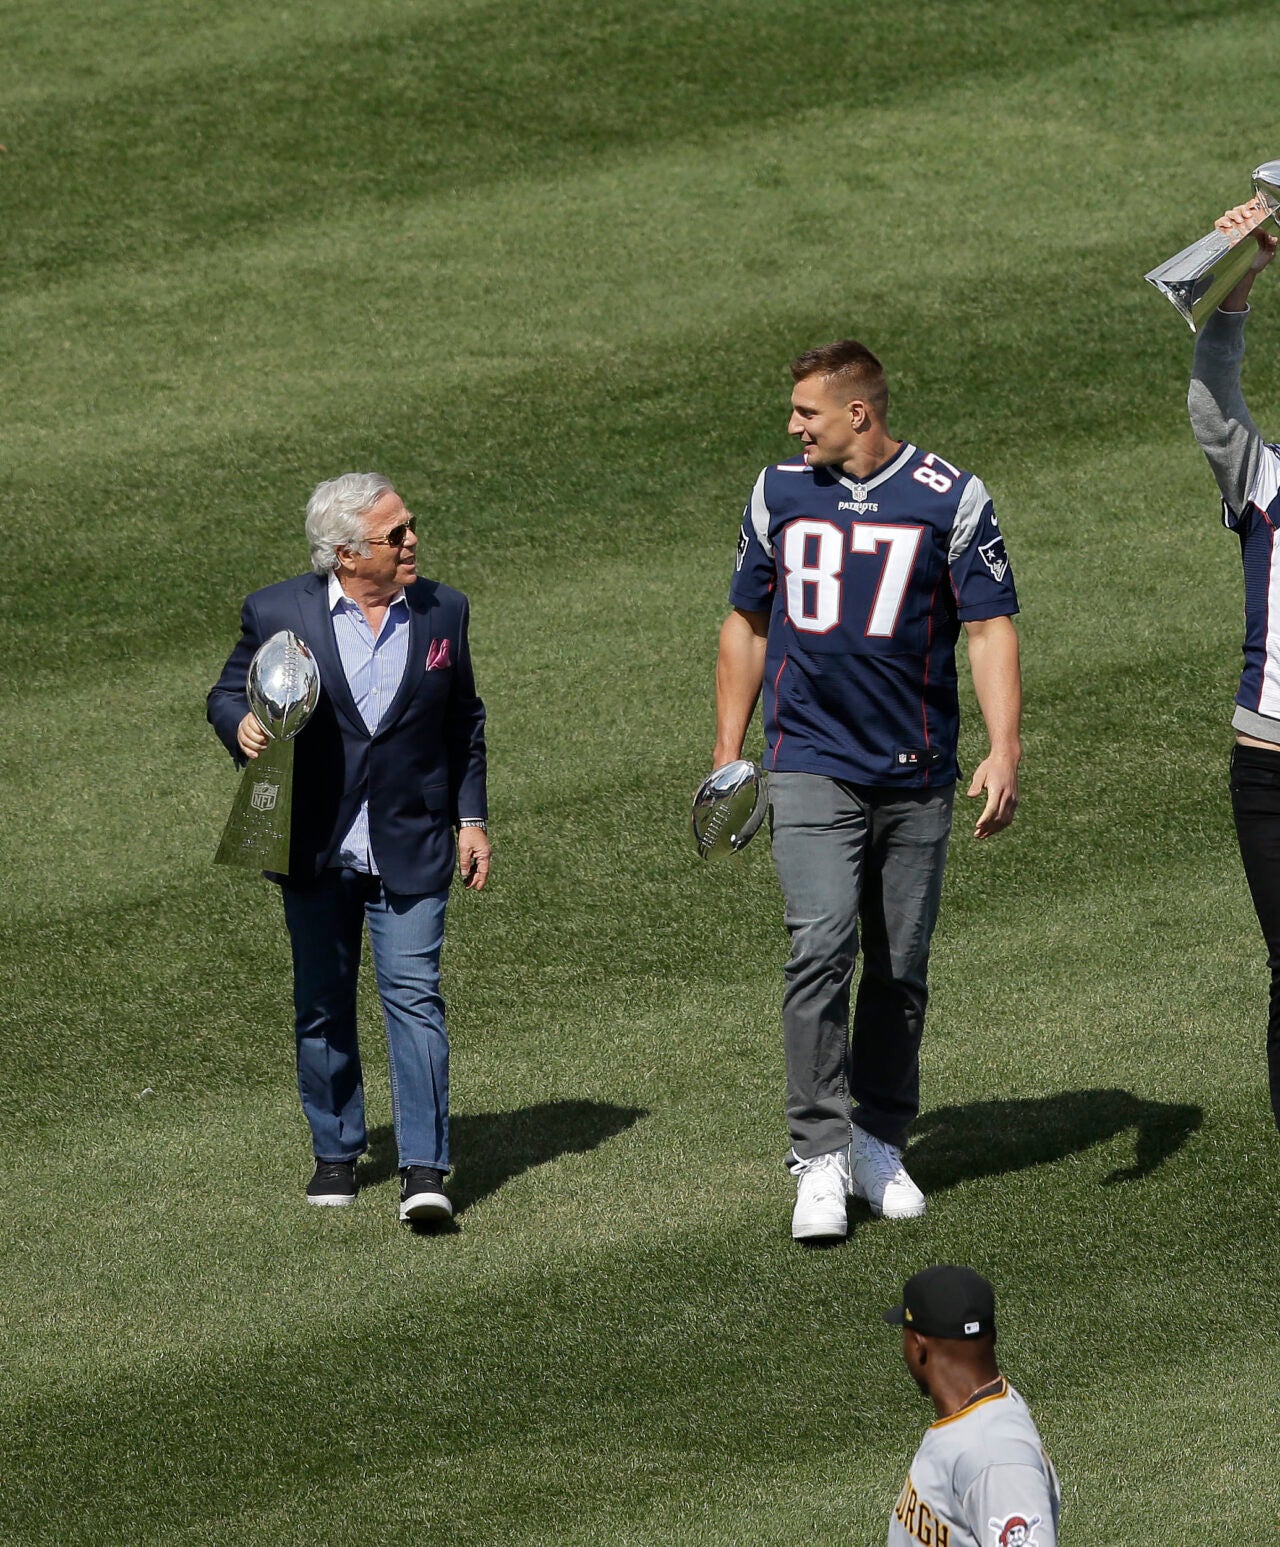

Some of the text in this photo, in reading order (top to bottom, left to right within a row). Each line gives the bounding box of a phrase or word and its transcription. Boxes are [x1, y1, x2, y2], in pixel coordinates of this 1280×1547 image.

[912, 452, 962, 494] 87
[838, 501, 879, 512] PATRIOTS
[782, 517, 925, 639] 87
[253, 794, 274, 809] NFL
